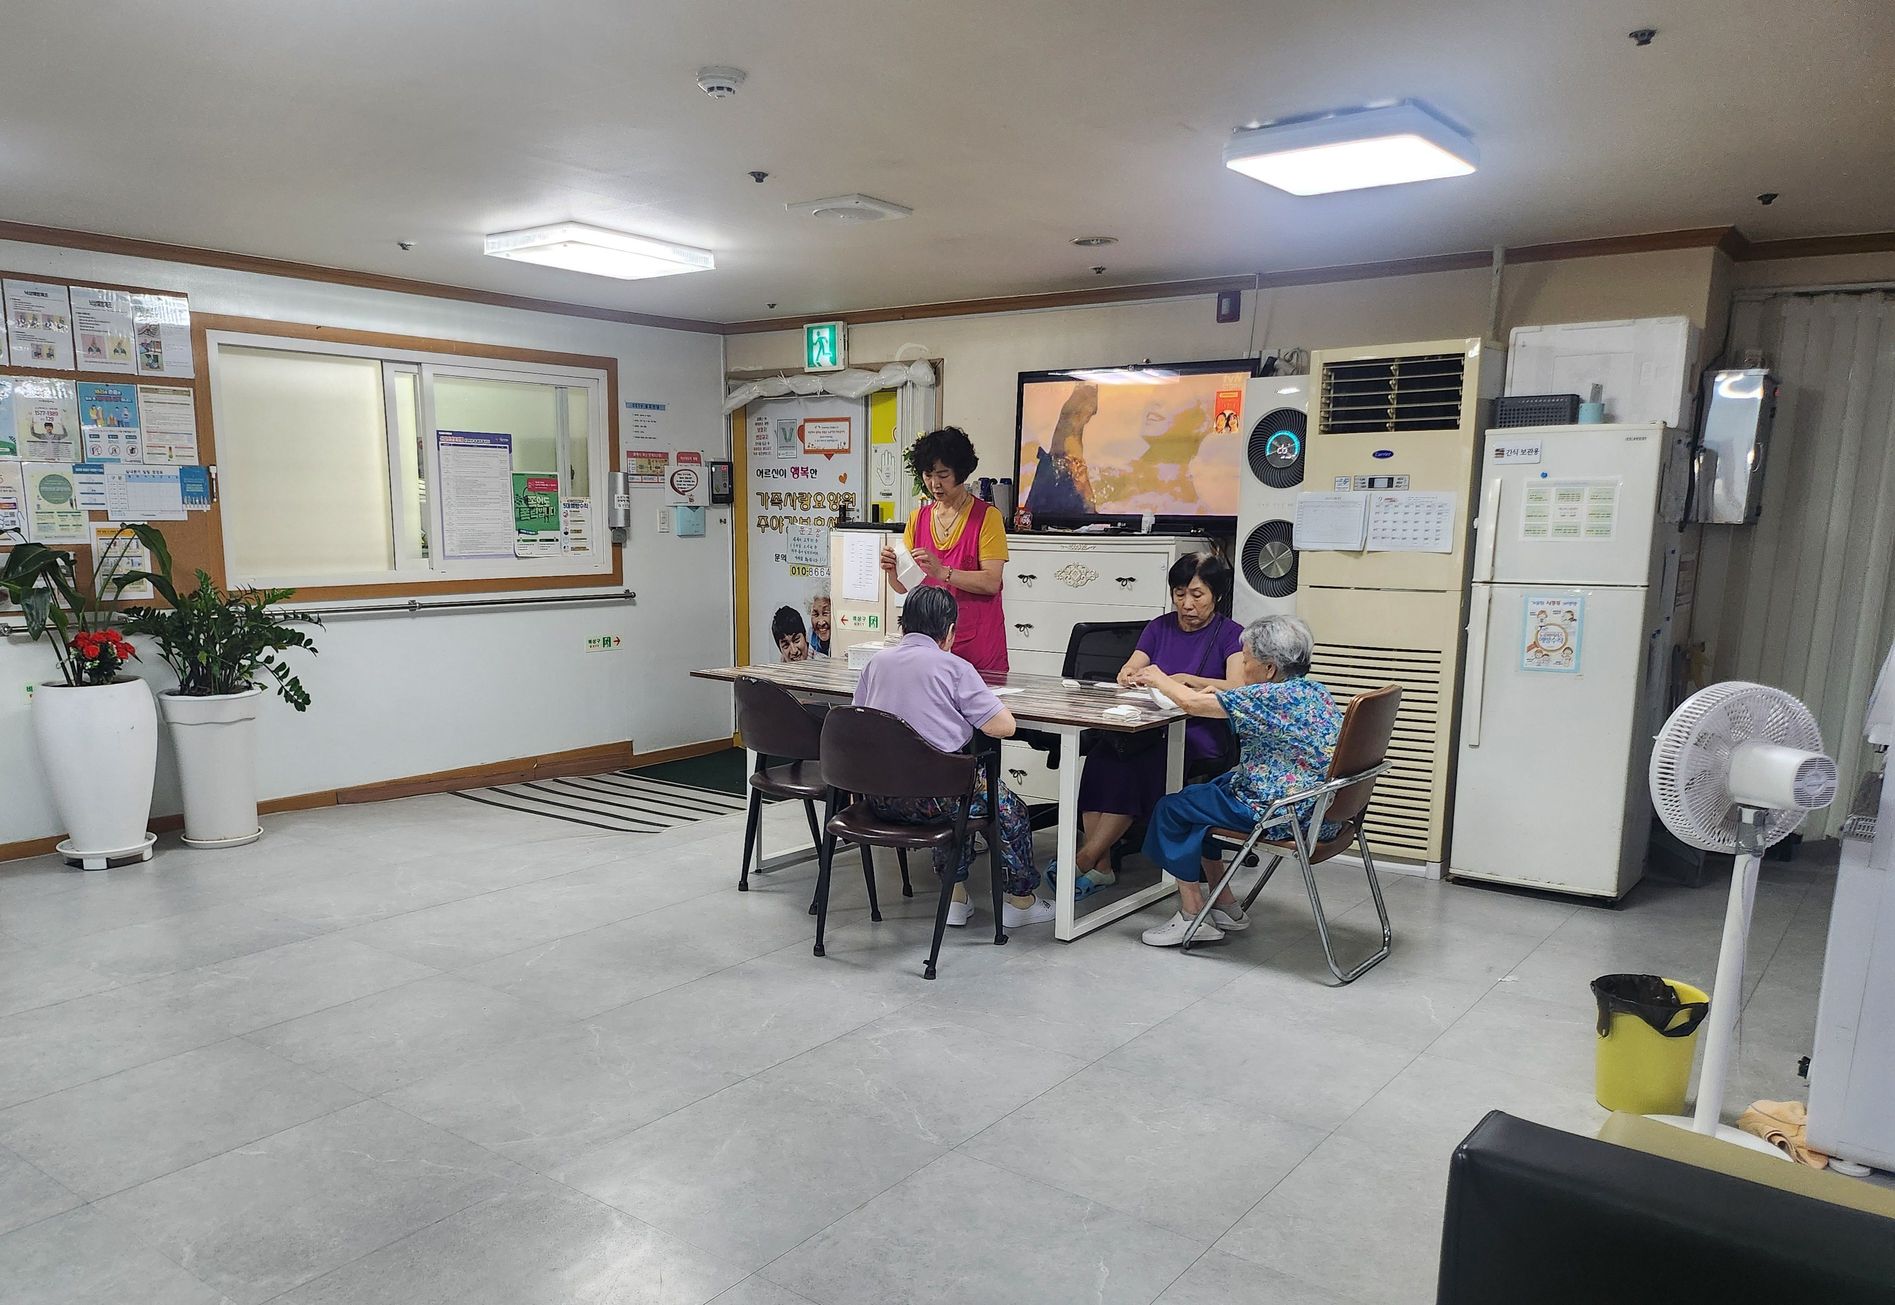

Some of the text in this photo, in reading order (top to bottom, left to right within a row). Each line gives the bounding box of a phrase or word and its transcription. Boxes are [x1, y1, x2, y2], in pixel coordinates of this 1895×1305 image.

[1506, 447, 1540, 457] 간식 보관용
[756, 468, 787, 479] 어르신이
[756, 491, 857, 511] 가족사랑요양원
